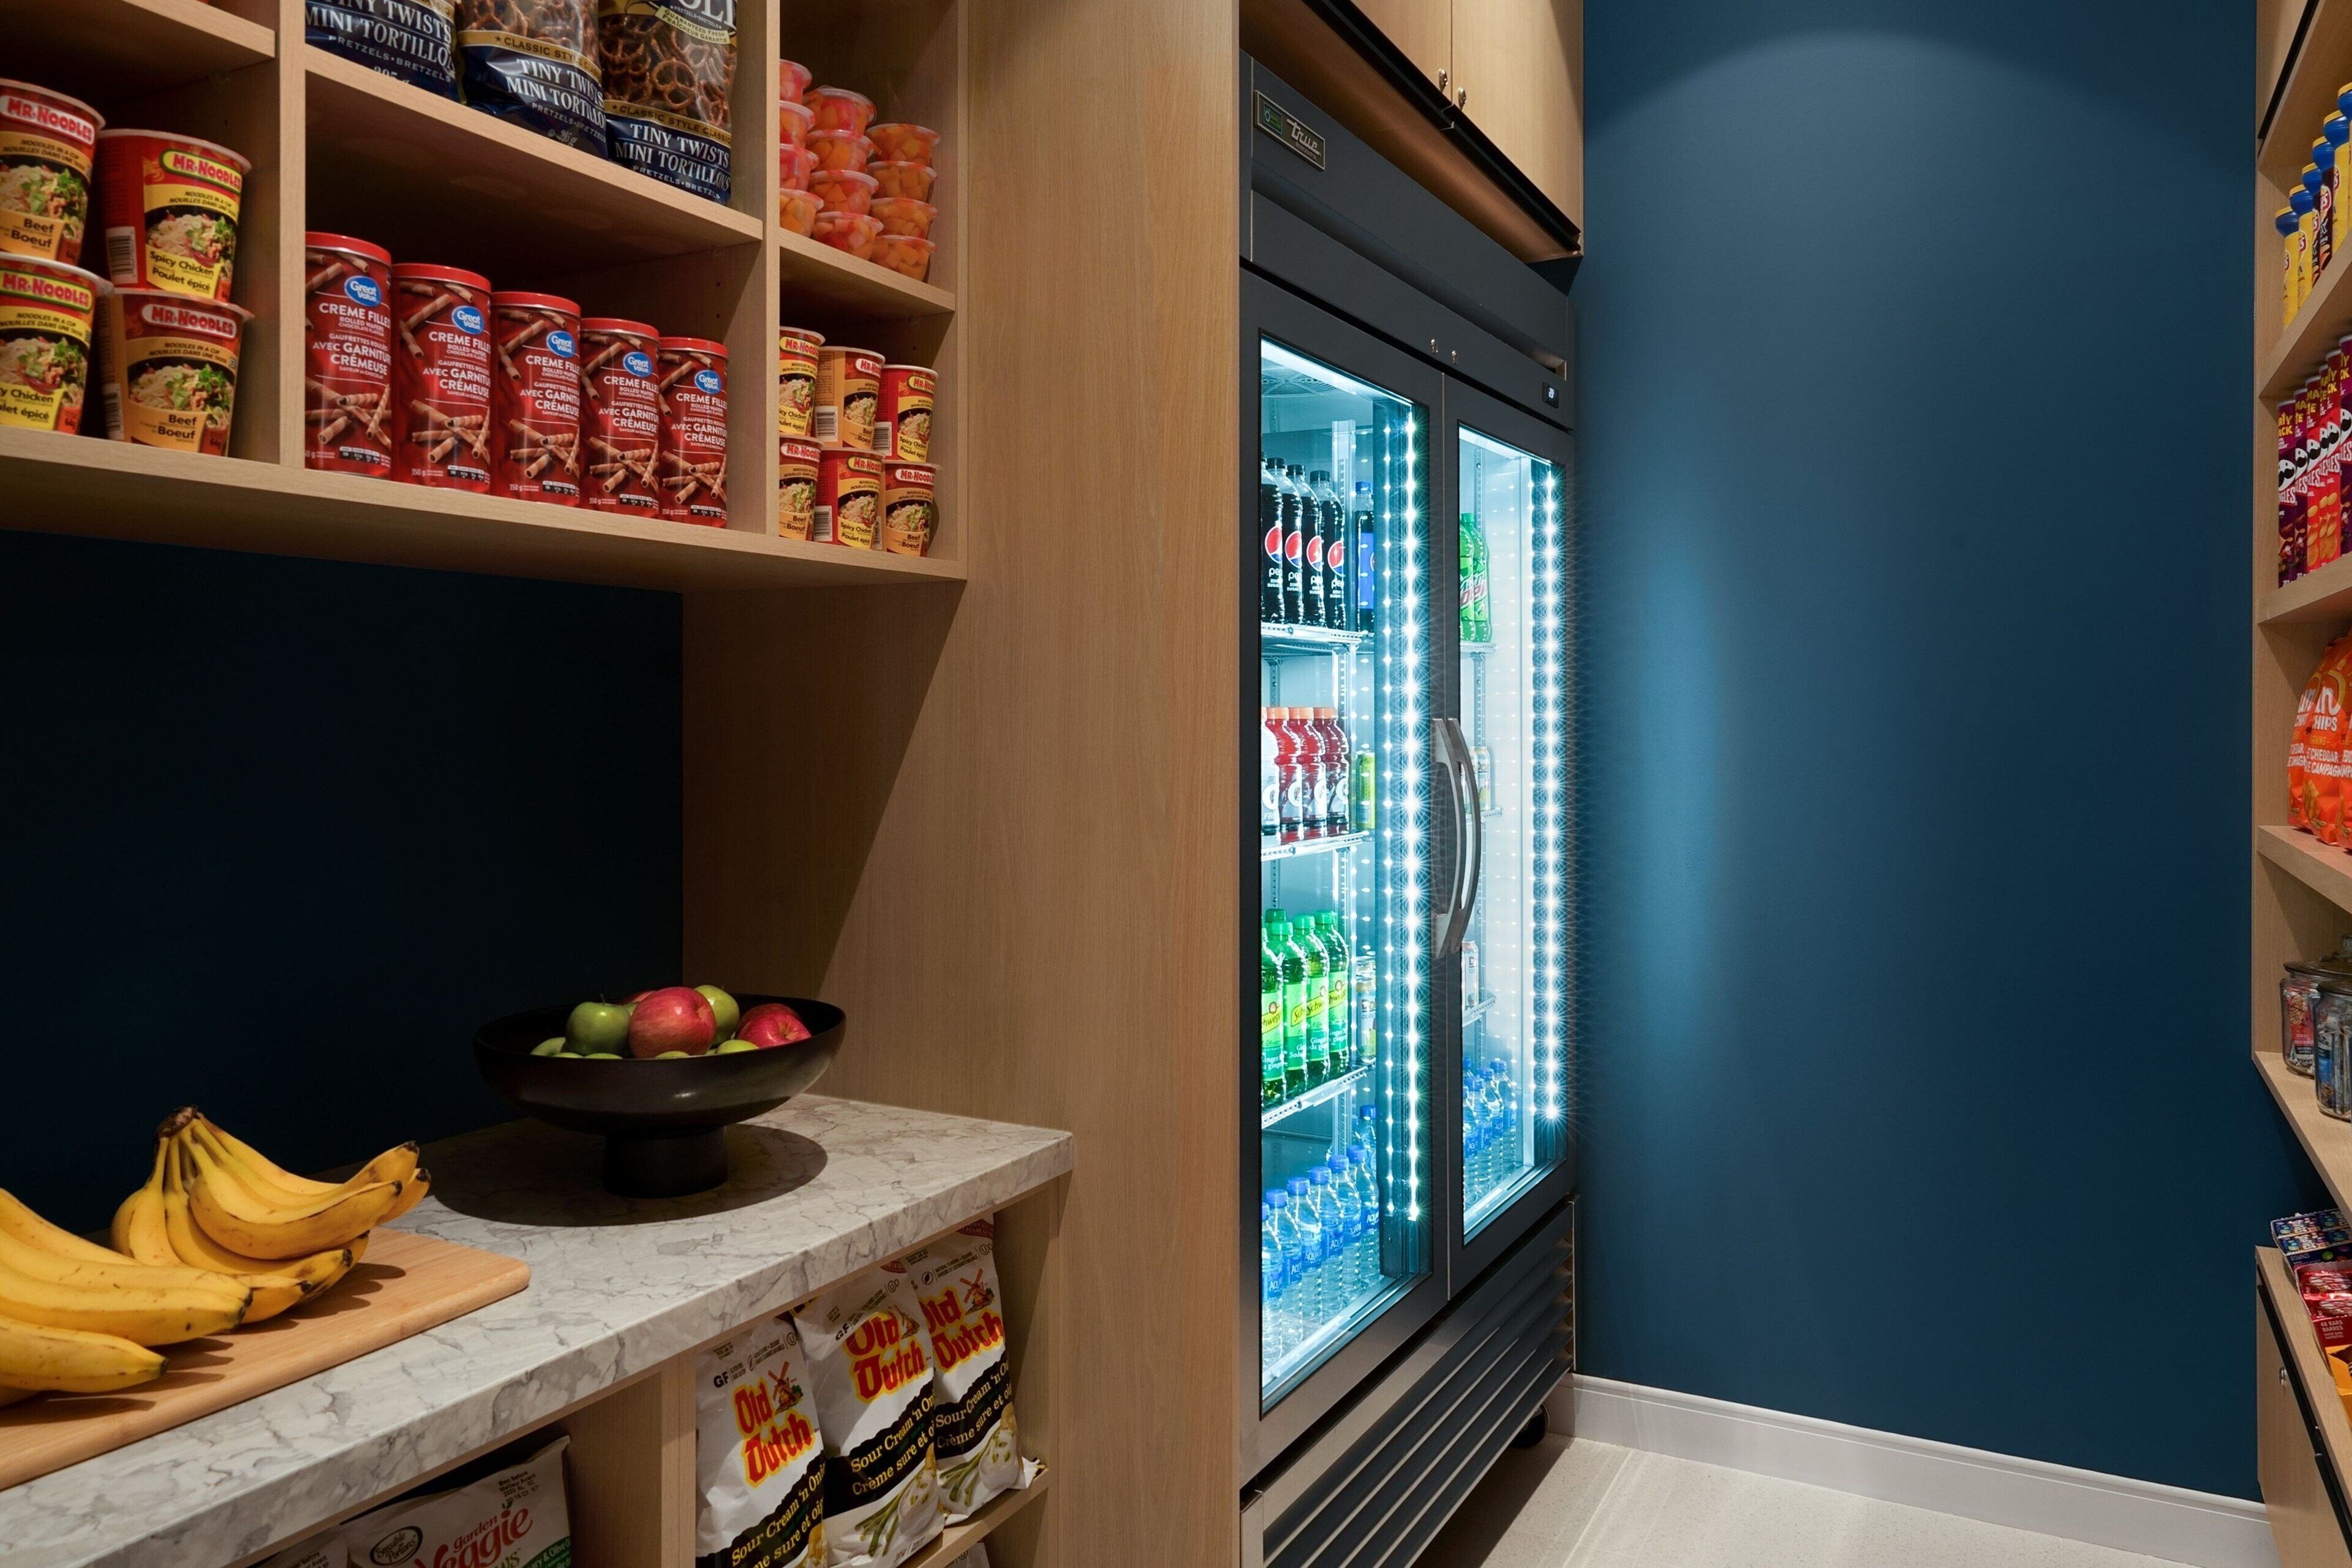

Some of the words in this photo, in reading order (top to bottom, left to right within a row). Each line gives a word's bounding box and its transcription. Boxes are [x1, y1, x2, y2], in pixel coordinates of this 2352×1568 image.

[384, 1, 451, 43] TWISTS
[665, 9, 706, 34] GUARANTEED
[708, 28, 725, 37] FRESH
[504, 37, 551, 56] CLASSIC
[701, 34, 727, 43] GARANTIE
[329, 35, 389, 61] PRETZELS
[396, 57, 451, 83] BRETZELS
[506, 77, 548, 102] MINI
[516, 58, 562, 84] TINY
[567, 70, 605, 108] TWISTS
[532, 102, 573, 125] PRETZELS
[620, 106, 665, 123] CLASSIC
[668, 117, 699, 132] STYLE
[615, 141, 653, 164] MINI
[630, 124, 672, 148] TINY
[677, 136, 729, 168] TWISTS
[633, 165, 680, 184] PRETZELS
[23, 217, 55, 233] Beef
[11, 229, 53, 248] Boeuf
[150, 251, 176, 268] Spicy
[179, 260, 214, 276] Chicken
[153, 267, 185, 284] Poulet
[187, 276, 211, 293] épicé
[350, 281, 377, 296] Great
[358, 292, 377, 303] Value
[319, 303, 366, 319] CREME
[457, 311, 481, 325] Great
[339, 317, 365, 326] ROLLED
[339, 322, 368, 332] CHOCOLATE
[464, 320, 481, 330] Value
[312, 342, 341, 351] AVEC
[328, 333, 370, 345] GAUFRETTES
[429, 331, 471, 346] CREME
[551, 335, 573, 349] Great
[447, 344, 471, 353] ROLLED
[557, 344, 573, 353] Value
[330, 353, 388, 375] CRÉMEUSE
[438, 360, 475, 371] GAUFRETTES
[526, 355, 564, 369] CREME
[627, 356, 649, 368] Great
[633, 364, 649, 373] Value
[423, 368, 448, 377] AVEC
[542, 366, 564, 375] ROLLED
[534, 382, 567, 391] GAUFRETTES
[603, 375, 640, 388] CREME
[698, 374, 718, 385] Great
[704, 382, 718, 391] Value
[10, 388, 54, 404] Chicken
[439, 378, 489, 398] CRÉMEUSE
[519, 389, 544, 398] AVEC
[611, 400, 643, 410] GAUFRETTES
[676, 393, 710, 405] CREME
[22, 408, 49, 421] épicé
[535, 399, 579, 417] CRÉMEUSE
[168, 414, 197, 426] Beef
[612, 417, 657, 433] CRÉMEUSE
[158, 426, 195, 439] Boeuf
[684, 432, 725, 447] CRÉMEUSE
[899, 436, 913, 446] Spicy
[900, 446, 916, 456] Poulet
[786, 523, 805, 532] Boeuf
[840, 522, 856, 532] Spicy
[842, 532, 859, 543] Poulet
[919, 1289, 961, 1336] Old
[835, 1322, 850, 1341] GF
[845, 1312, 900, 1356] Old
[933, 1311, 1004, 1371] Dutch
[854, 1343, 925, 1400] Dutch
[714, 1371, 729, 1389] GF
[735, 1380, 774, 1434] Old
[935, 1409, 967, 1428] Sour
[966, 1381, 992, 1414] Cream
[937, 1428, 975, 1449] Crème
[976, 1406, 992, 1432] sure
[993, 1394, 1003, 1410] et
[745, 1411, 812, 1483] Dutch
[851, 1445, 883, 1472] Sour
[884, 1417, 914, 1451] Cream
[853, 1466, 894, 1495] Crème
[896, 1444, 918, 1471] sure
[918, 1431, 928, 1448] et
[453, 1515, 497, 1554] garden
[732, 1532, 764, 1567] Sour
[766, 1499, 800, 1538] Cream
[774, 1529, 801, 1559] sure
[801, 1513, 811, 1532] et
